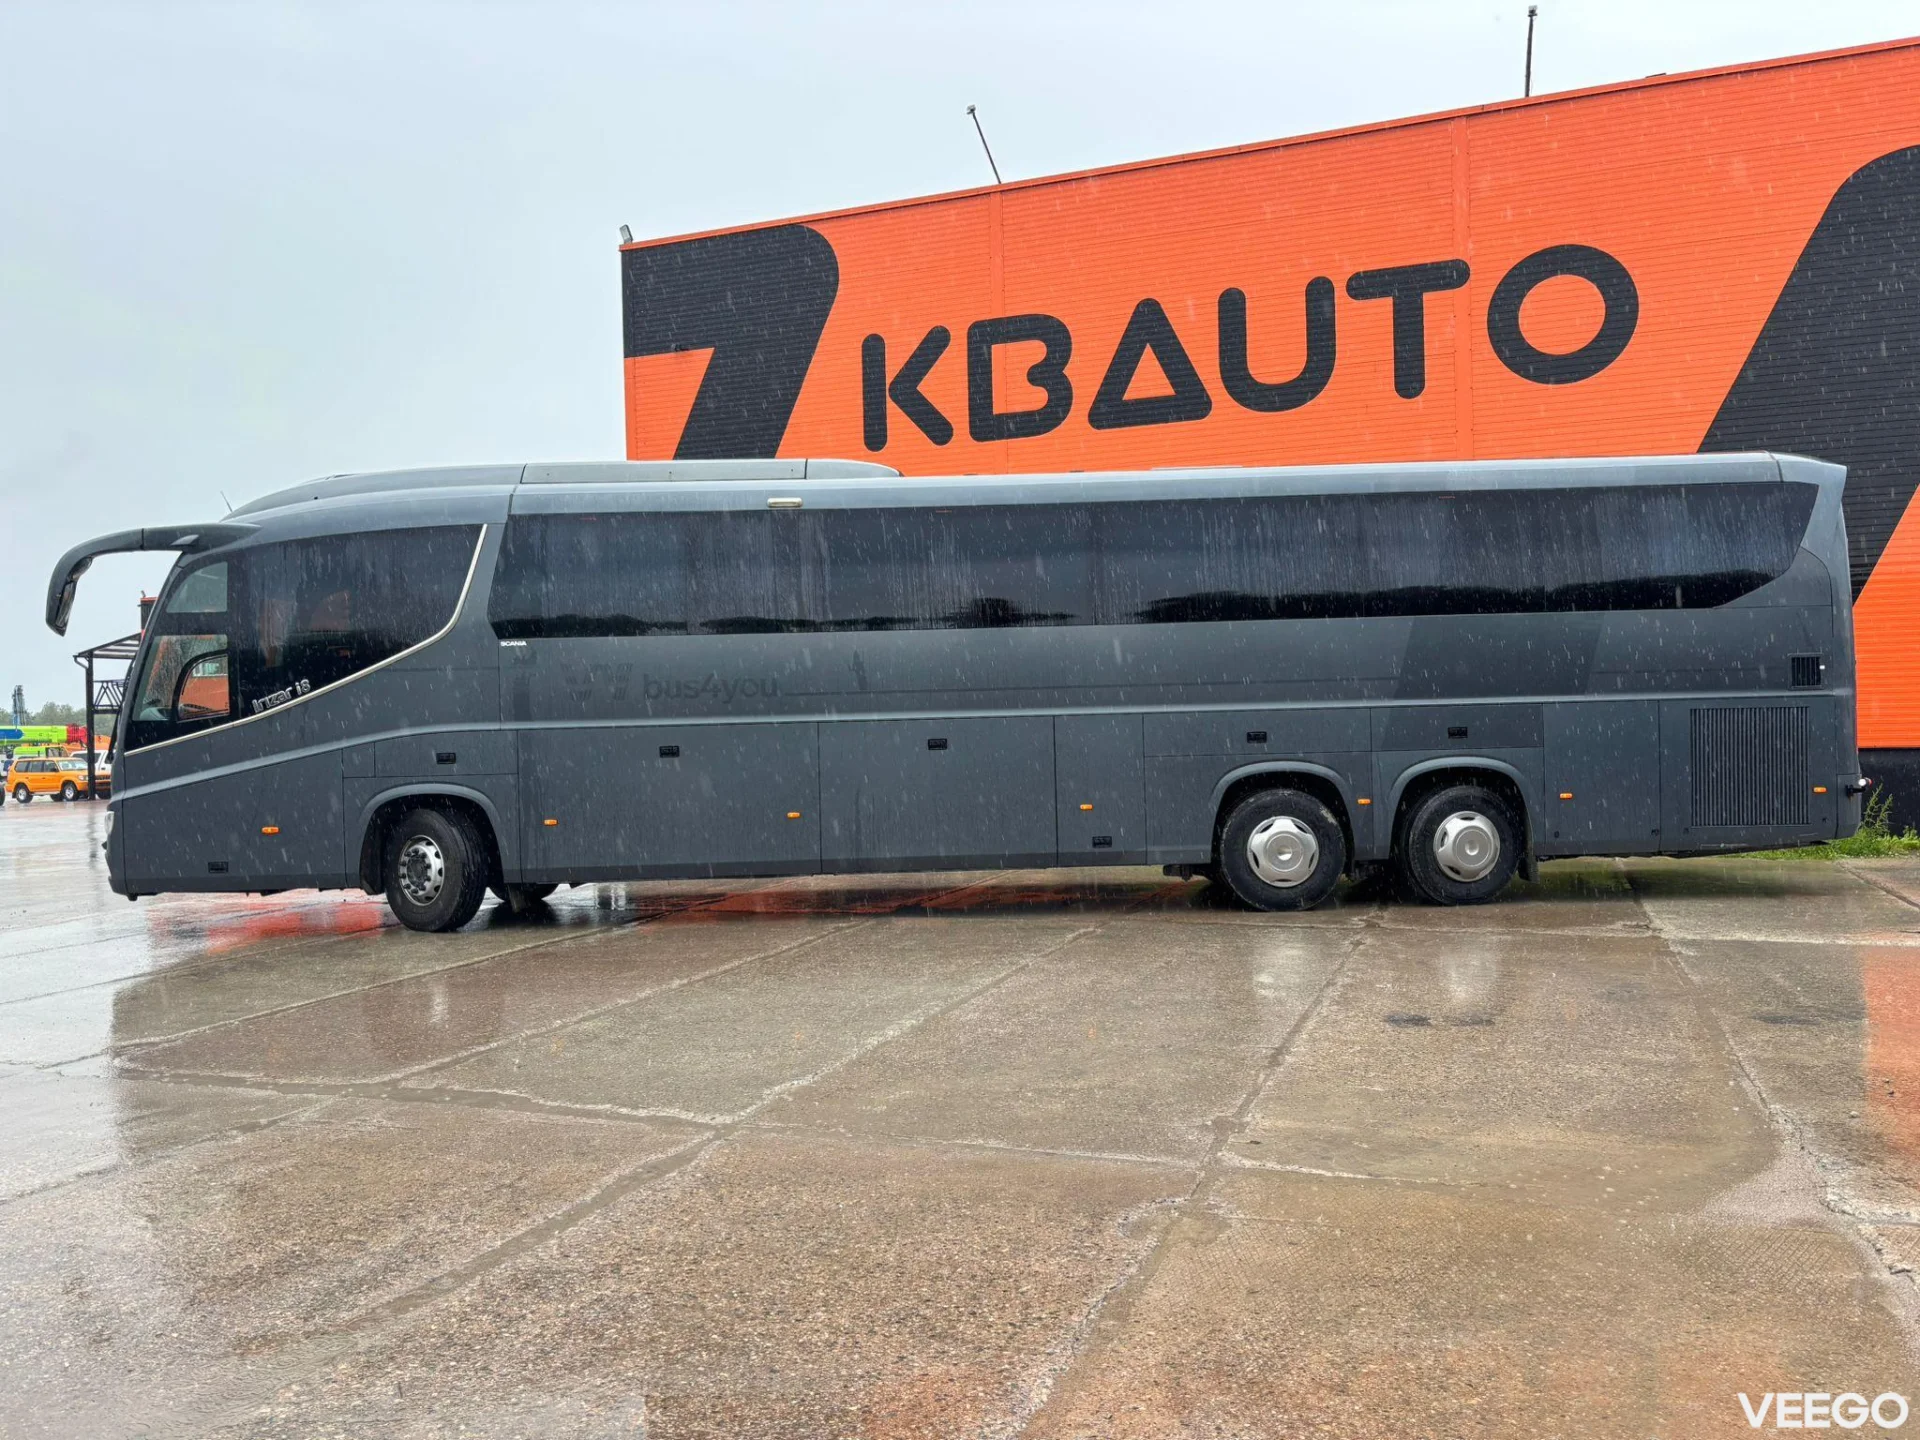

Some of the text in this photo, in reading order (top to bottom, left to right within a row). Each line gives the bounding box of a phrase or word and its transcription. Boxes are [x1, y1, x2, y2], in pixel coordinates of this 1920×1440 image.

[861, 244, 1639, 452] KBAUTO
[295, 679, 311, 695] i8
[643, 672, 778, 704] bus4you
